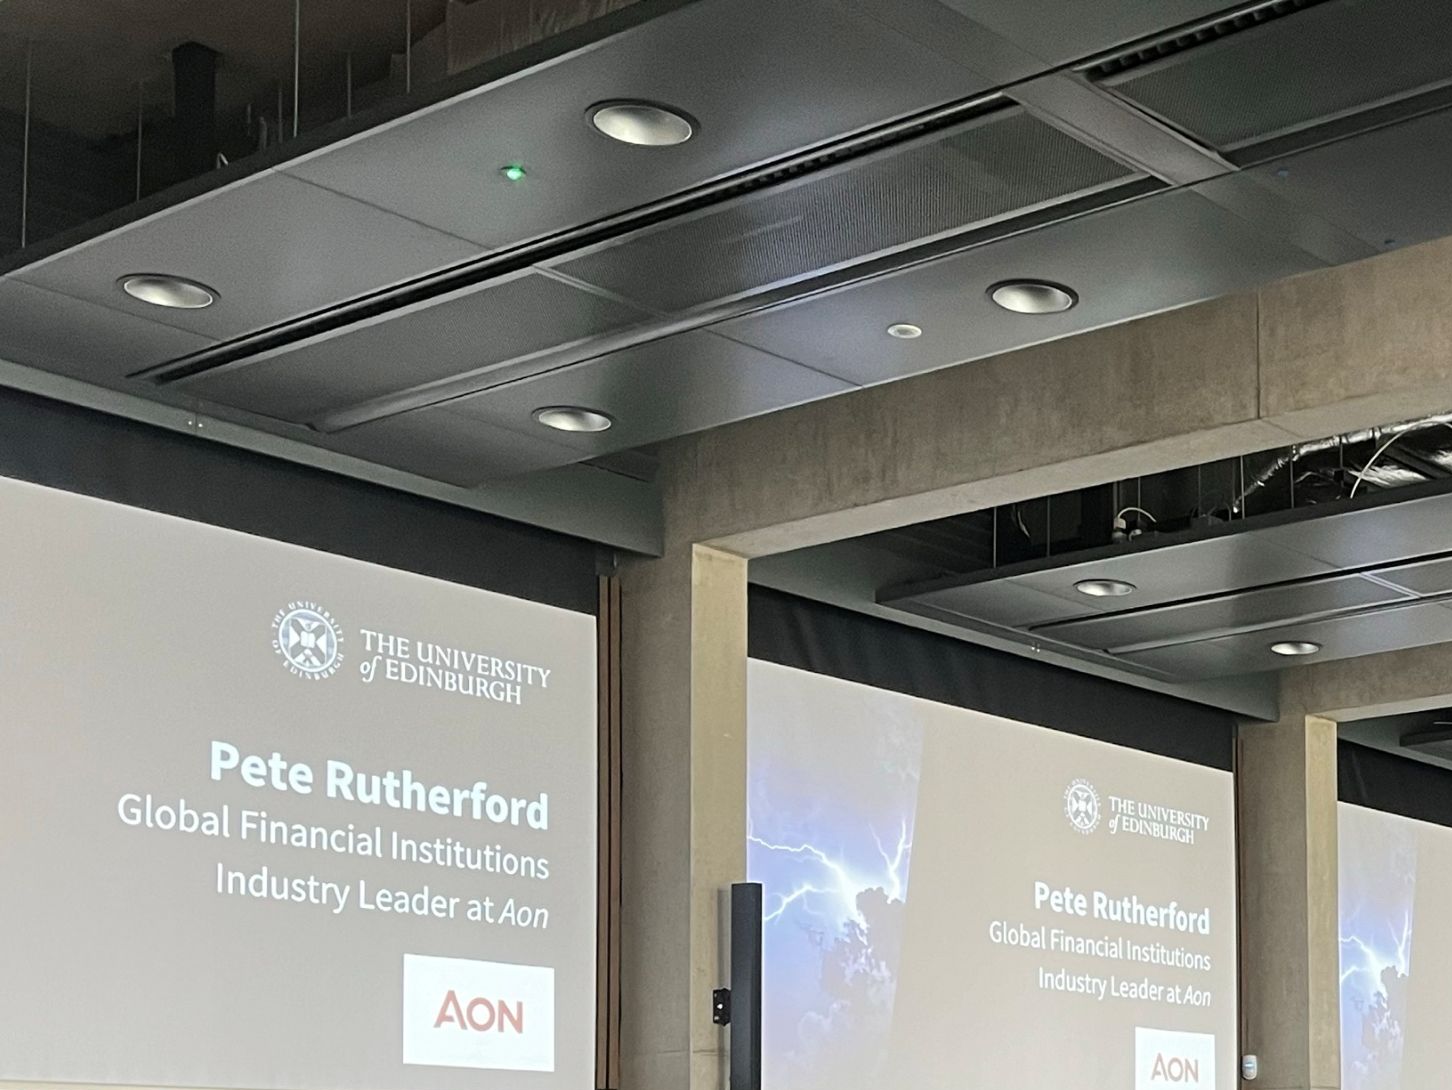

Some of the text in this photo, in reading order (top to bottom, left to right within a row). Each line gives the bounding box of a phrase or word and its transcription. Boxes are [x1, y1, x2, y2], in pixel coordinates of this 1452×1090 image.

[360, 628, 551, 688] THE UNIVERSITY
[360, 655, 522, 705] of EDINBURGH
[210, 740, 549, 830] Pete Rutherford
[117, 793, 550, 880] Global Financial Institutions
[1108, 795, 1135, 815] THE
[1138, 802, 1210, 831] UNIVERSITY
[1108, 814, 1195, 845] of EDINBURGH
[216, 862, 549, 930] Industry Leader at Aon
[1034, 880, 1211, 935] Pete Rutherford
[989, 920, 1212, 971] Global Financial Institutions
[433, 989, 524, 1034] AON
[1039, 966, 1211, 1007] Industry Leader at Aon
[1150, 1052, 1199, 1083] AON
